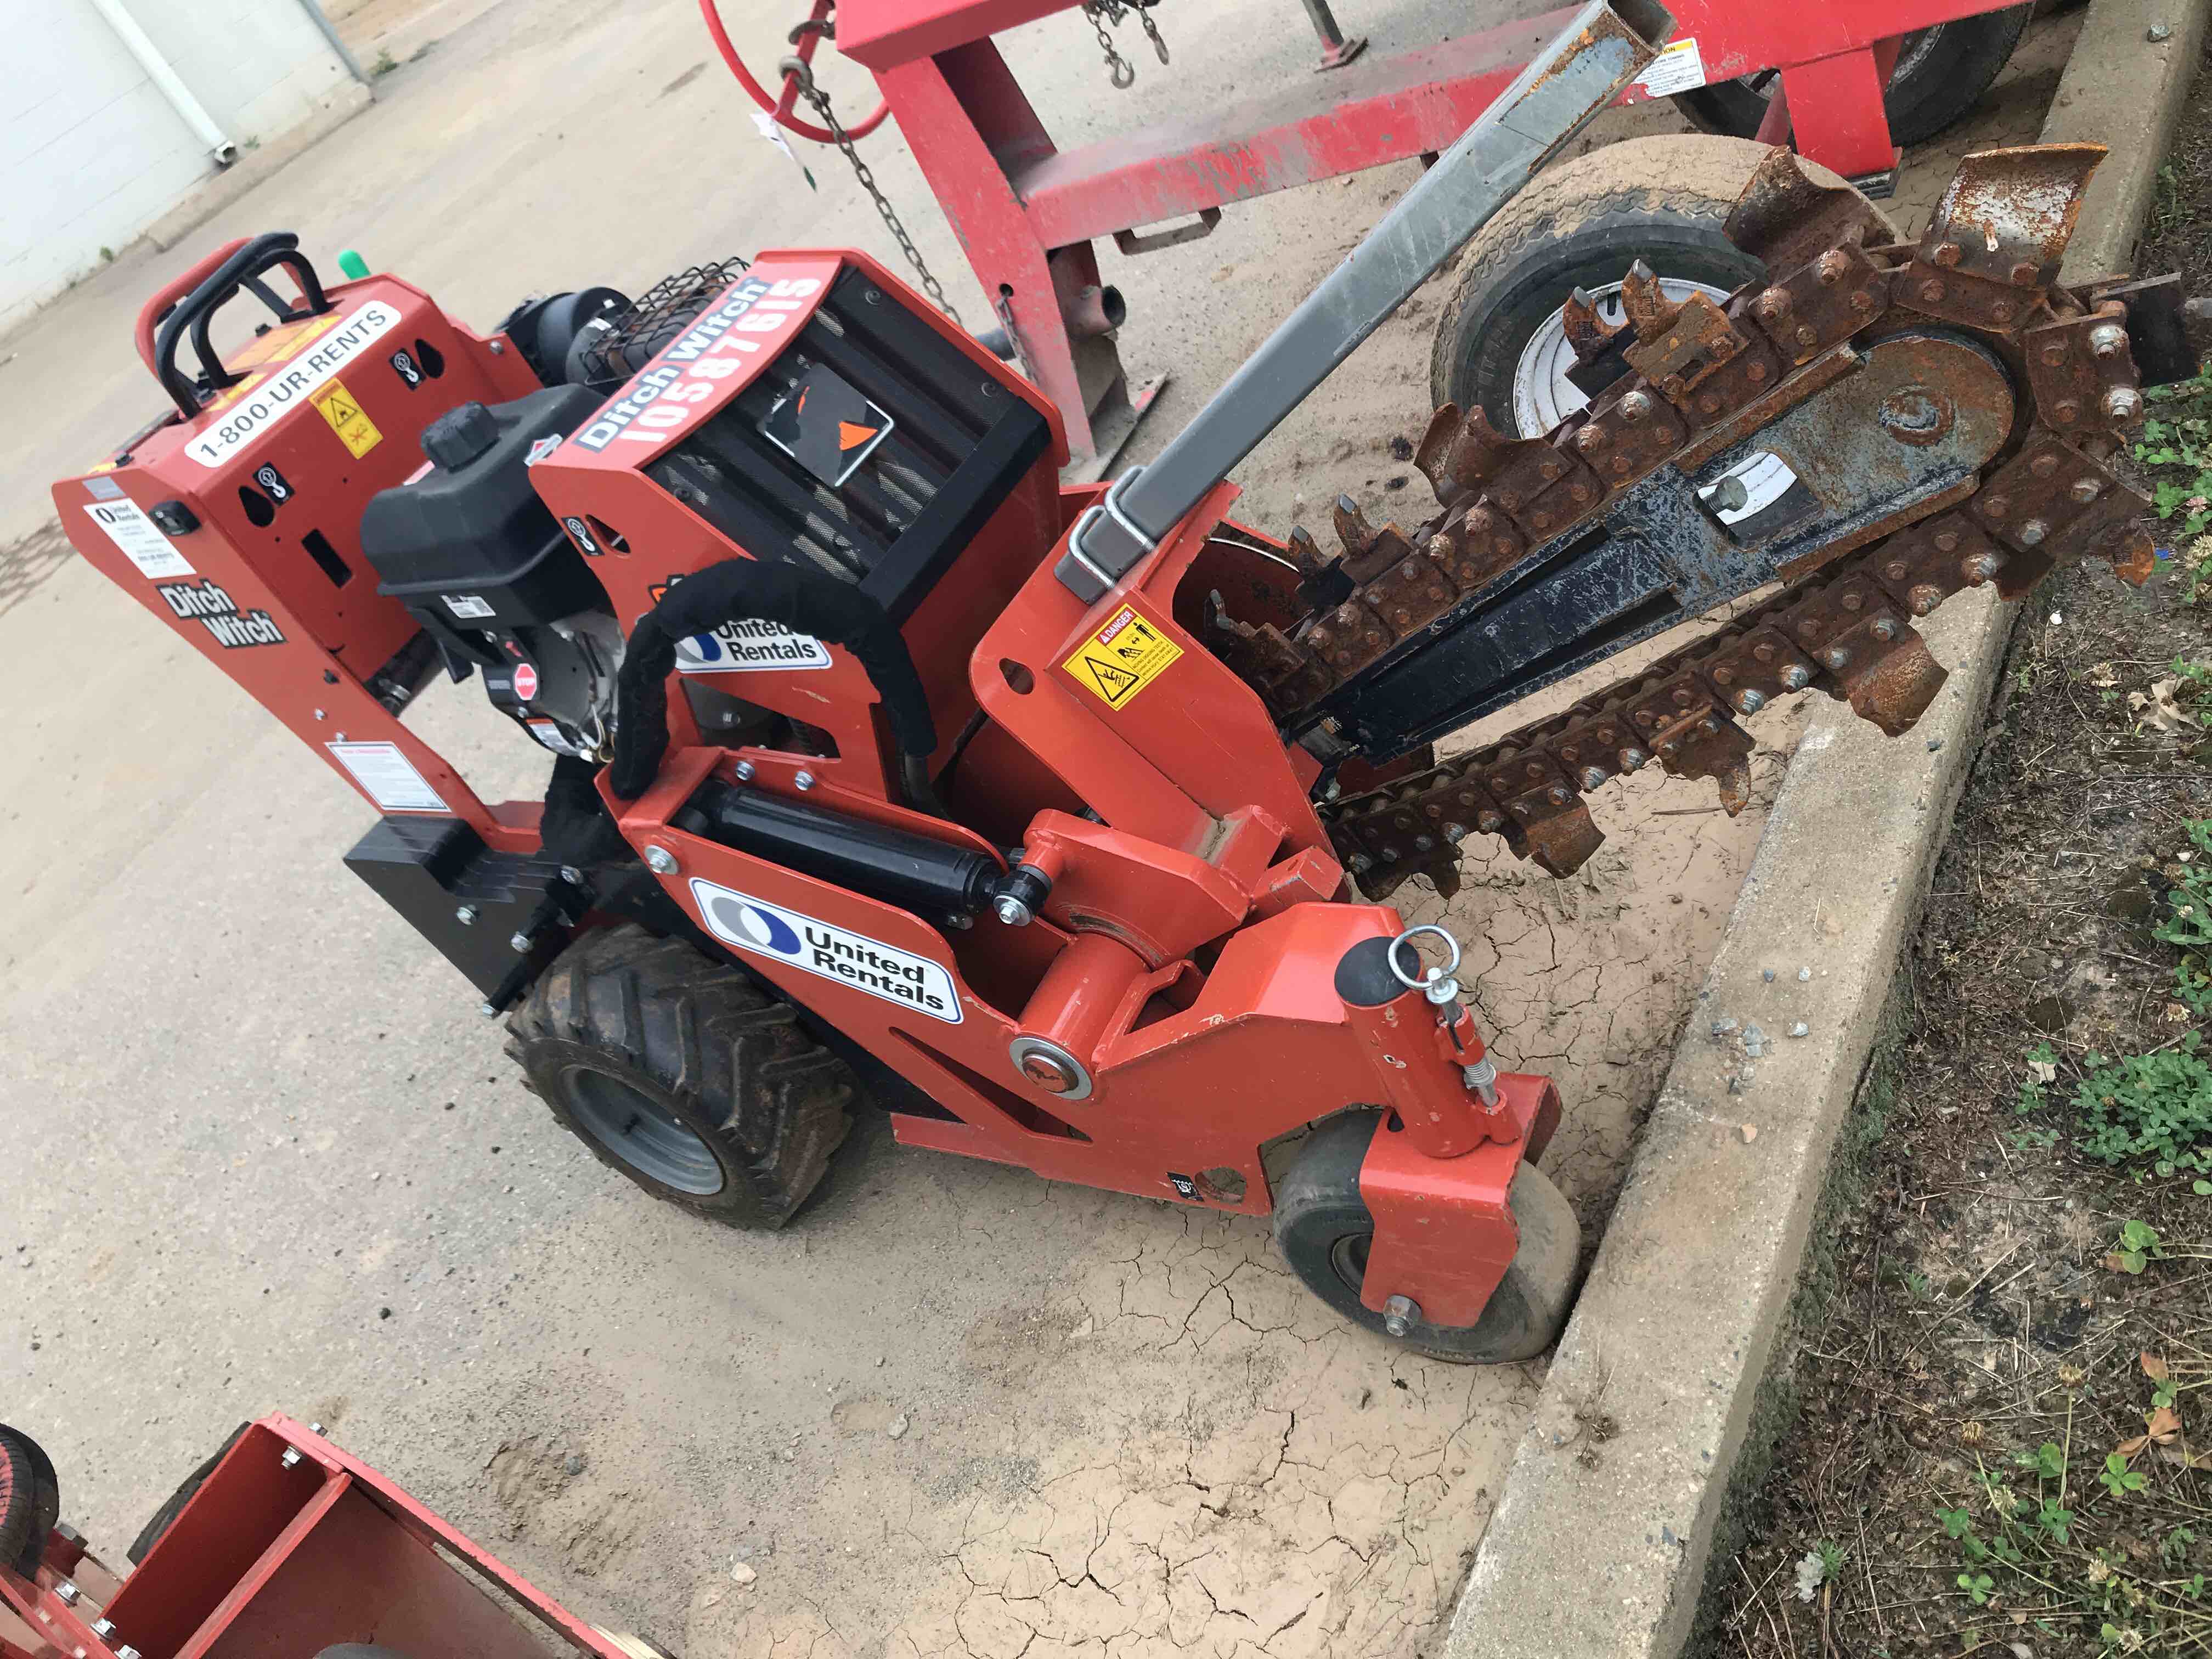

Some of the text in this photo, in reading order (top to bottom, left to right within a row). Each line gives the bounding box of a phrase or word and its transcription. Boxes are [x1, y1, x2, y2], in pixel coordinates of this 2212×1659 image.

[200, 308, 387, 458] 1-800-UR-RENTS
[579, 281, 768, 449] Ditch Witch
[619, 277, 821, 443] 10587615
[157, 579, 238, 618] Ditch
[1104, 610, 1135, 639] DANGER
[200, 610, 286, 648] Witch
[725, 639, 817, 662] Rentals
[805, 926, 925, 985] United
[812, 947, 944, 1011] Rentals
